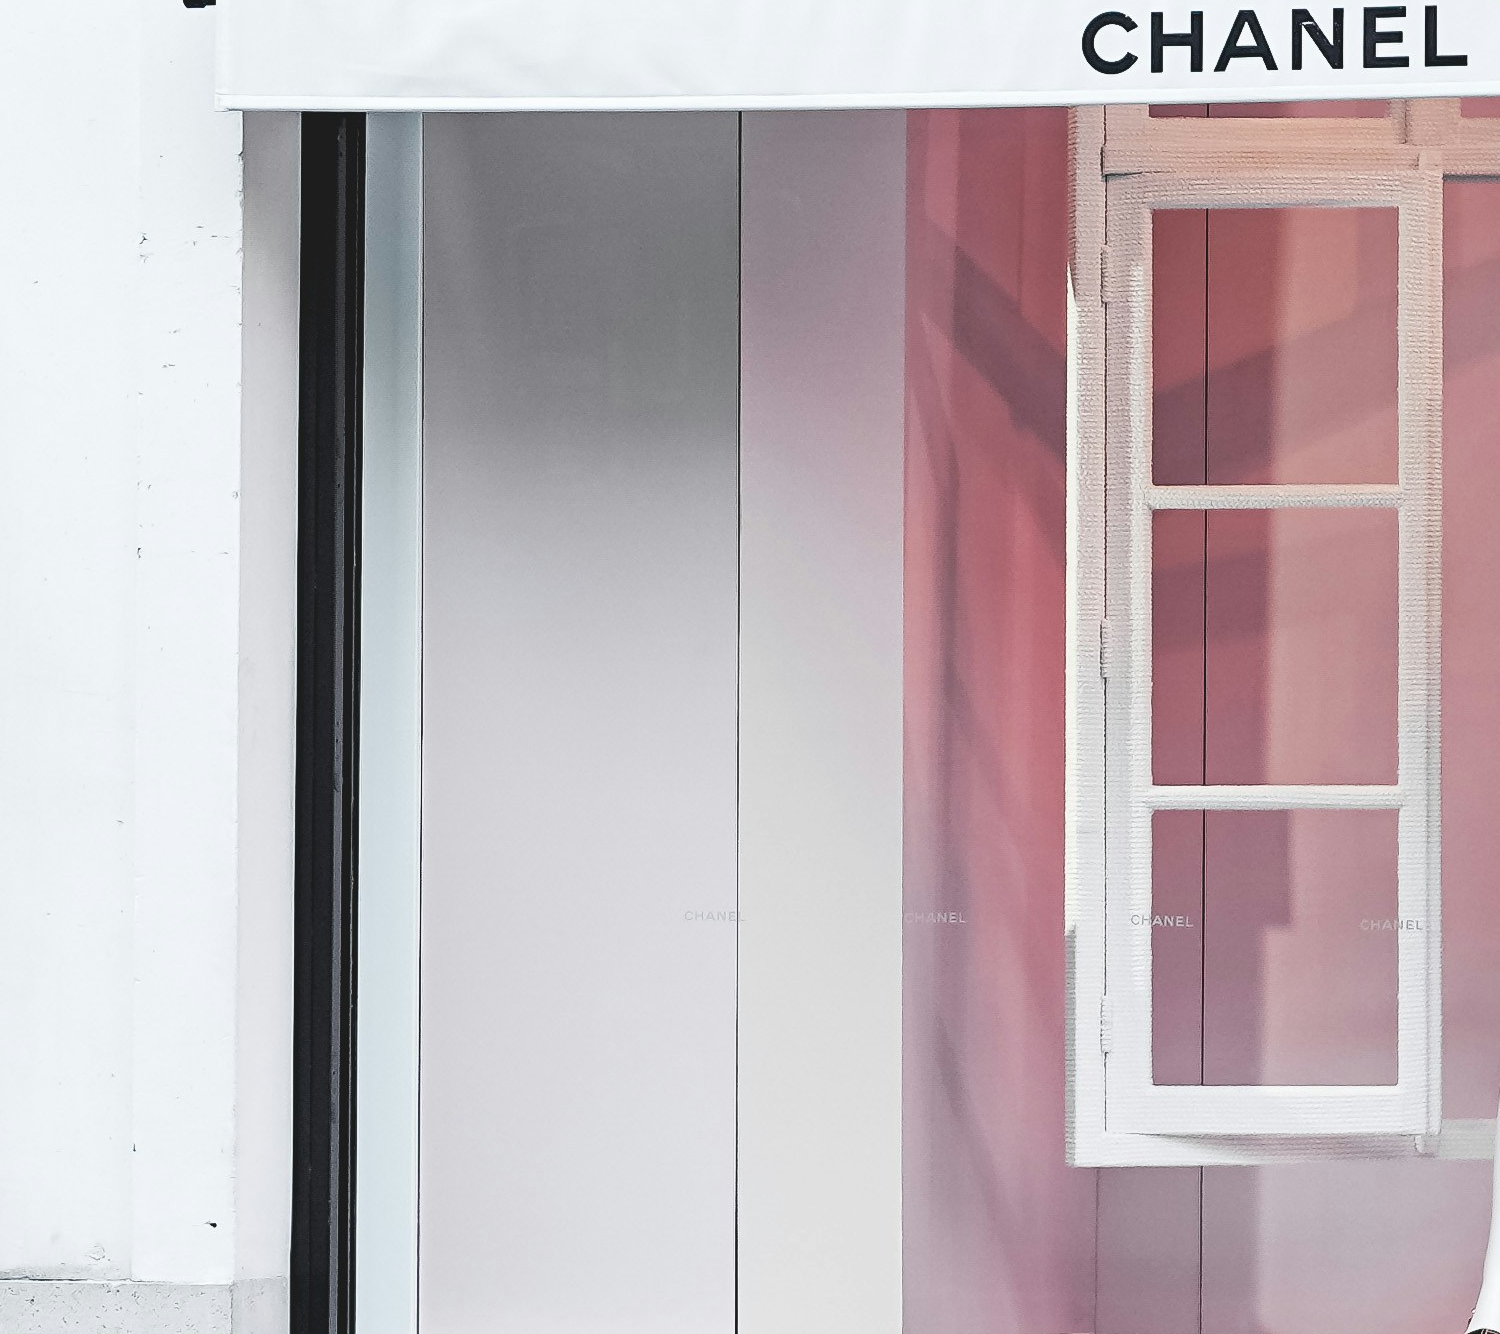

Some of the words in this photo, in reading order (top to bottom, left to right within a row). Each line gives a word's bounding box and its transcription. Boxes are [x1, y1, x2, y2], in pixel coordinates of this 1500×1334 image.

[1082, 5, 1468, 74] CHANEL
[684, 910, 746, 922] CHANEL
[904, 911, 967, 924] CHANEL
[1131, 914, 1194, 928] CHANEL
[1360, 919, 1423, 931] CHANEL
